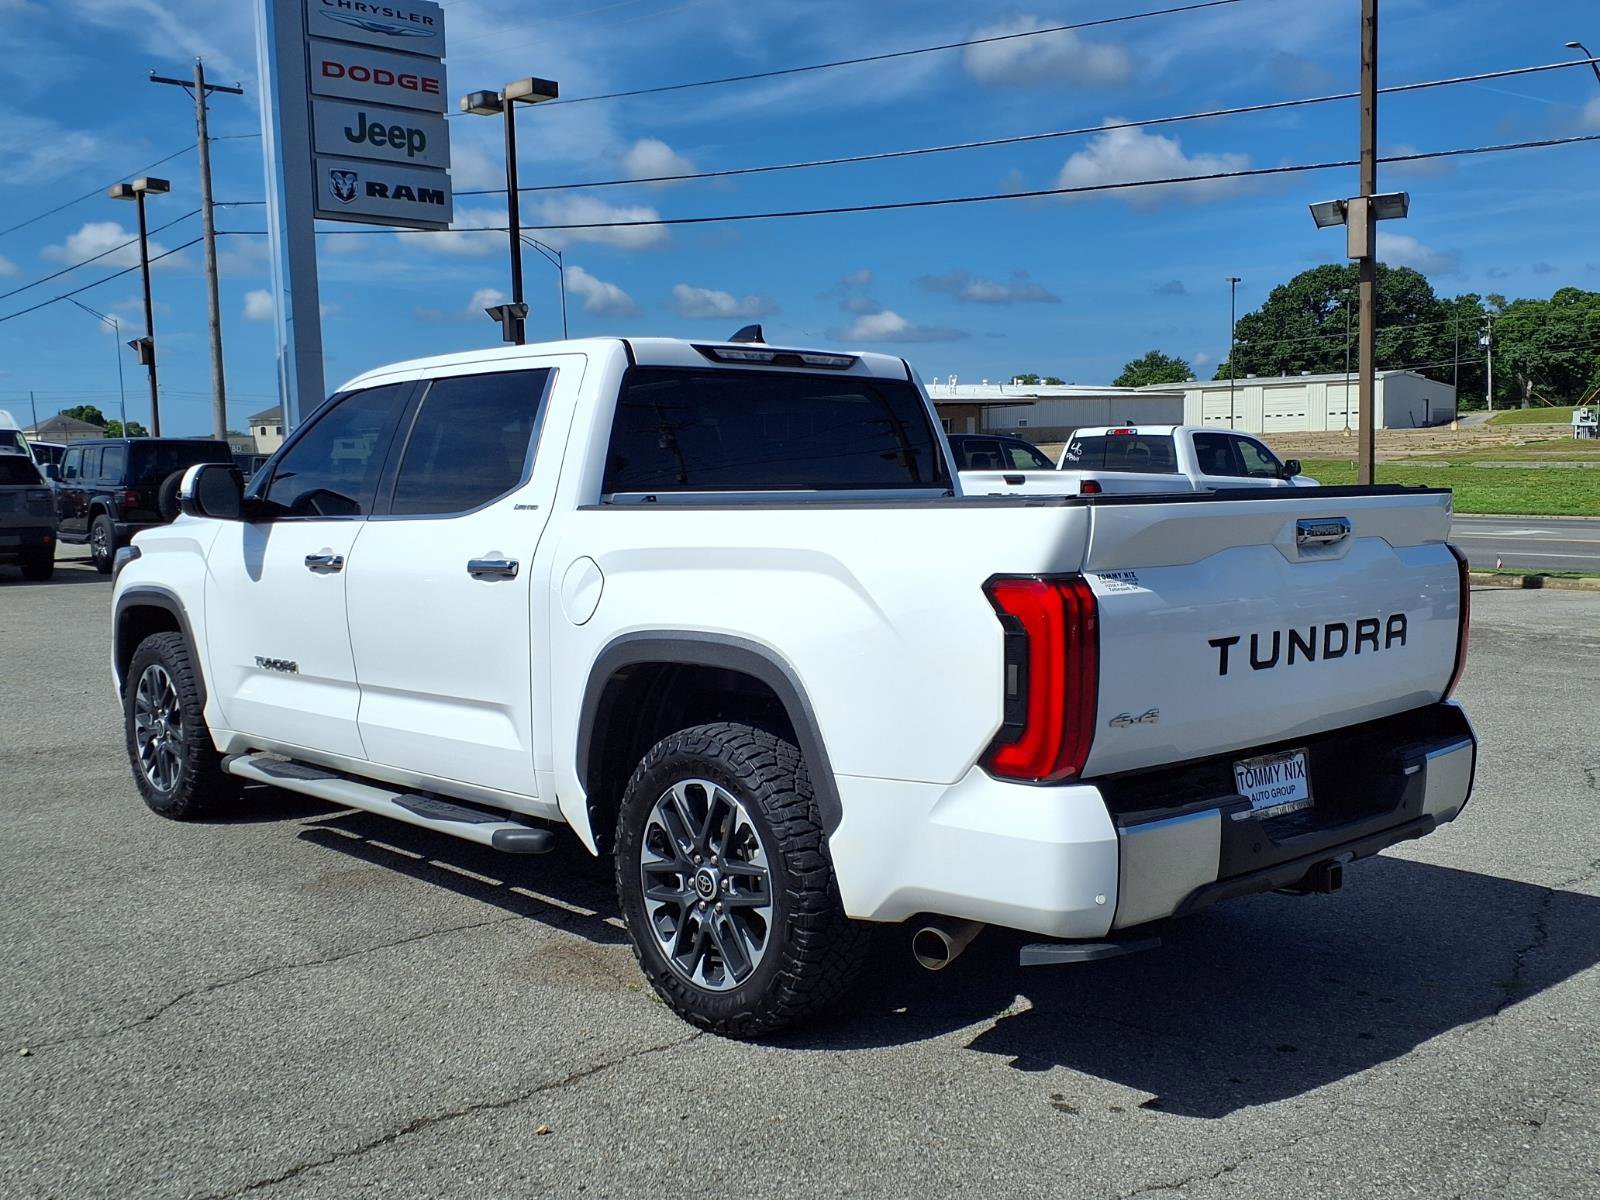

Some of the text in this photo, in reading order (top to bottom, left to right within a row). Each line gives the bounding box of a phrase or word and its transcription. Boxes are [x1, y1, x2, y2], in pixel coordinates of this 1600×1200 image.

[322, 0, 434, 26] CHRYSLER
[322, 61, 440, 94] DODGE
[344, 112, 426, 157] Jeep
[365, 181, 445, 206] RAM
[1097, 572, 1122, 581] TOMMY
[1207, 613, 1408, 676] TUNDRA
[1237, 759, 1305, 790] TOMMY NIX
[1251, 784, 1296, 803] AUTO GROUP
